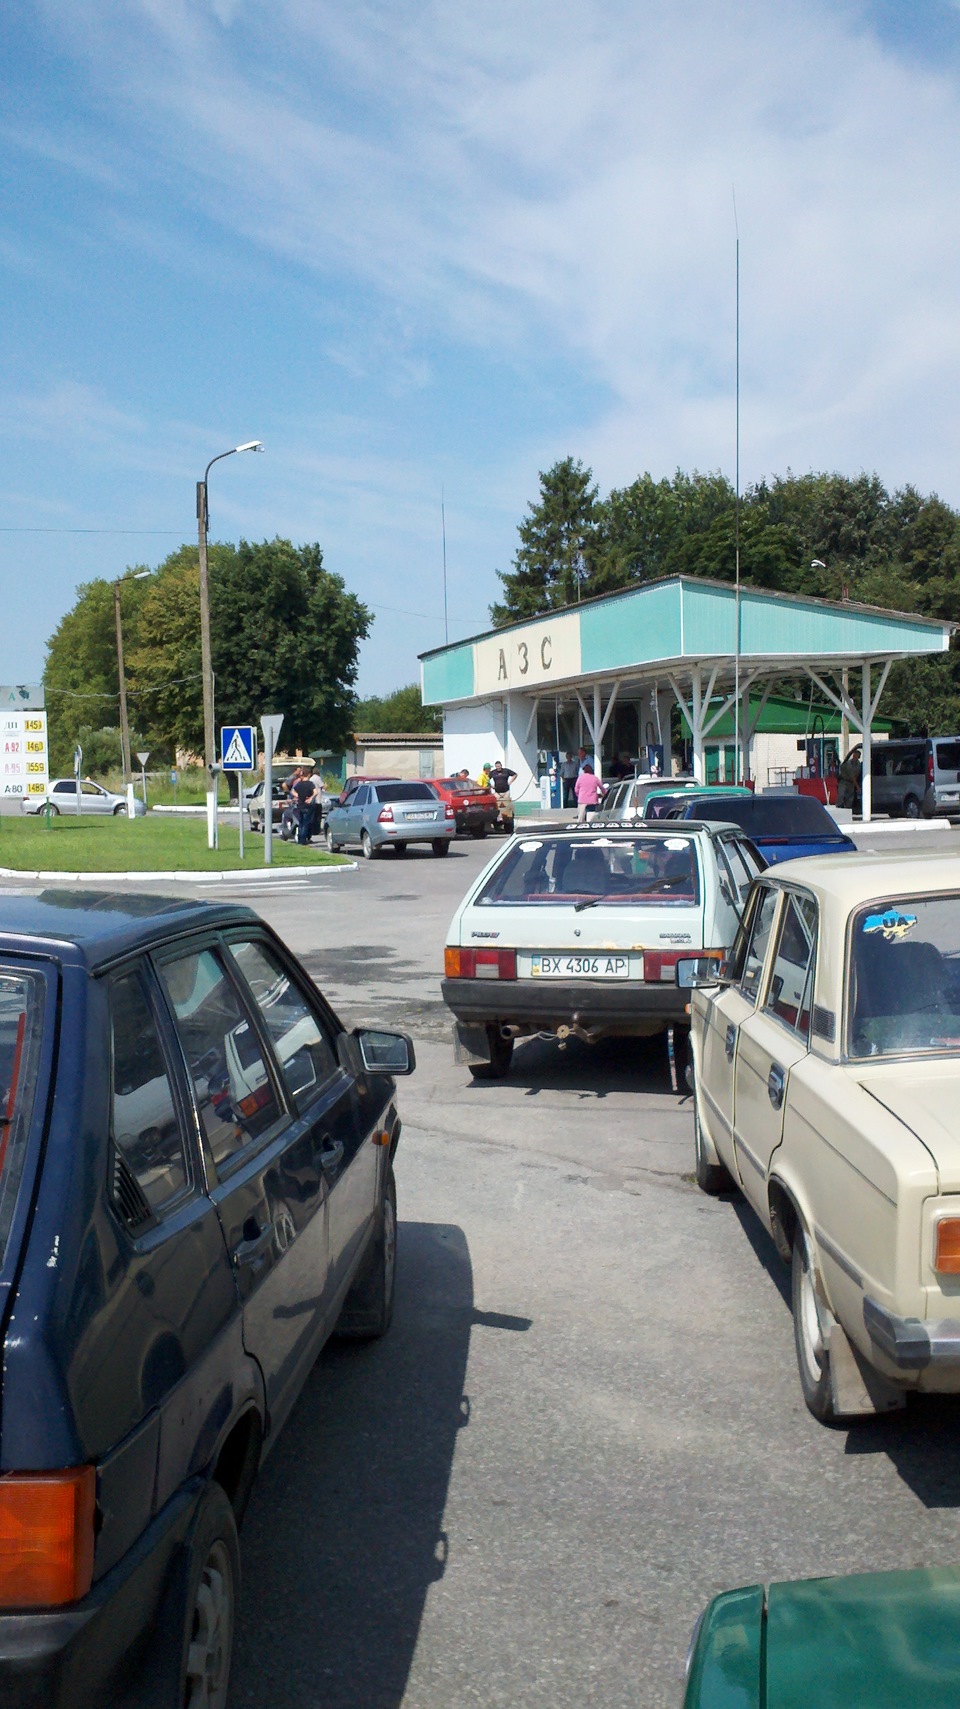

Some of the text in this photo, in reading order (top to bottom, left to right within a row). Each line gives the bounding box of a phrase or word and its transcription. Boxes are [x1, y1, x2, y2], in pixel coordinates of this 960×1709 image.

[882, 916, 909, 929] UA
[541, 958, 625, 974] BX 4306 AP
